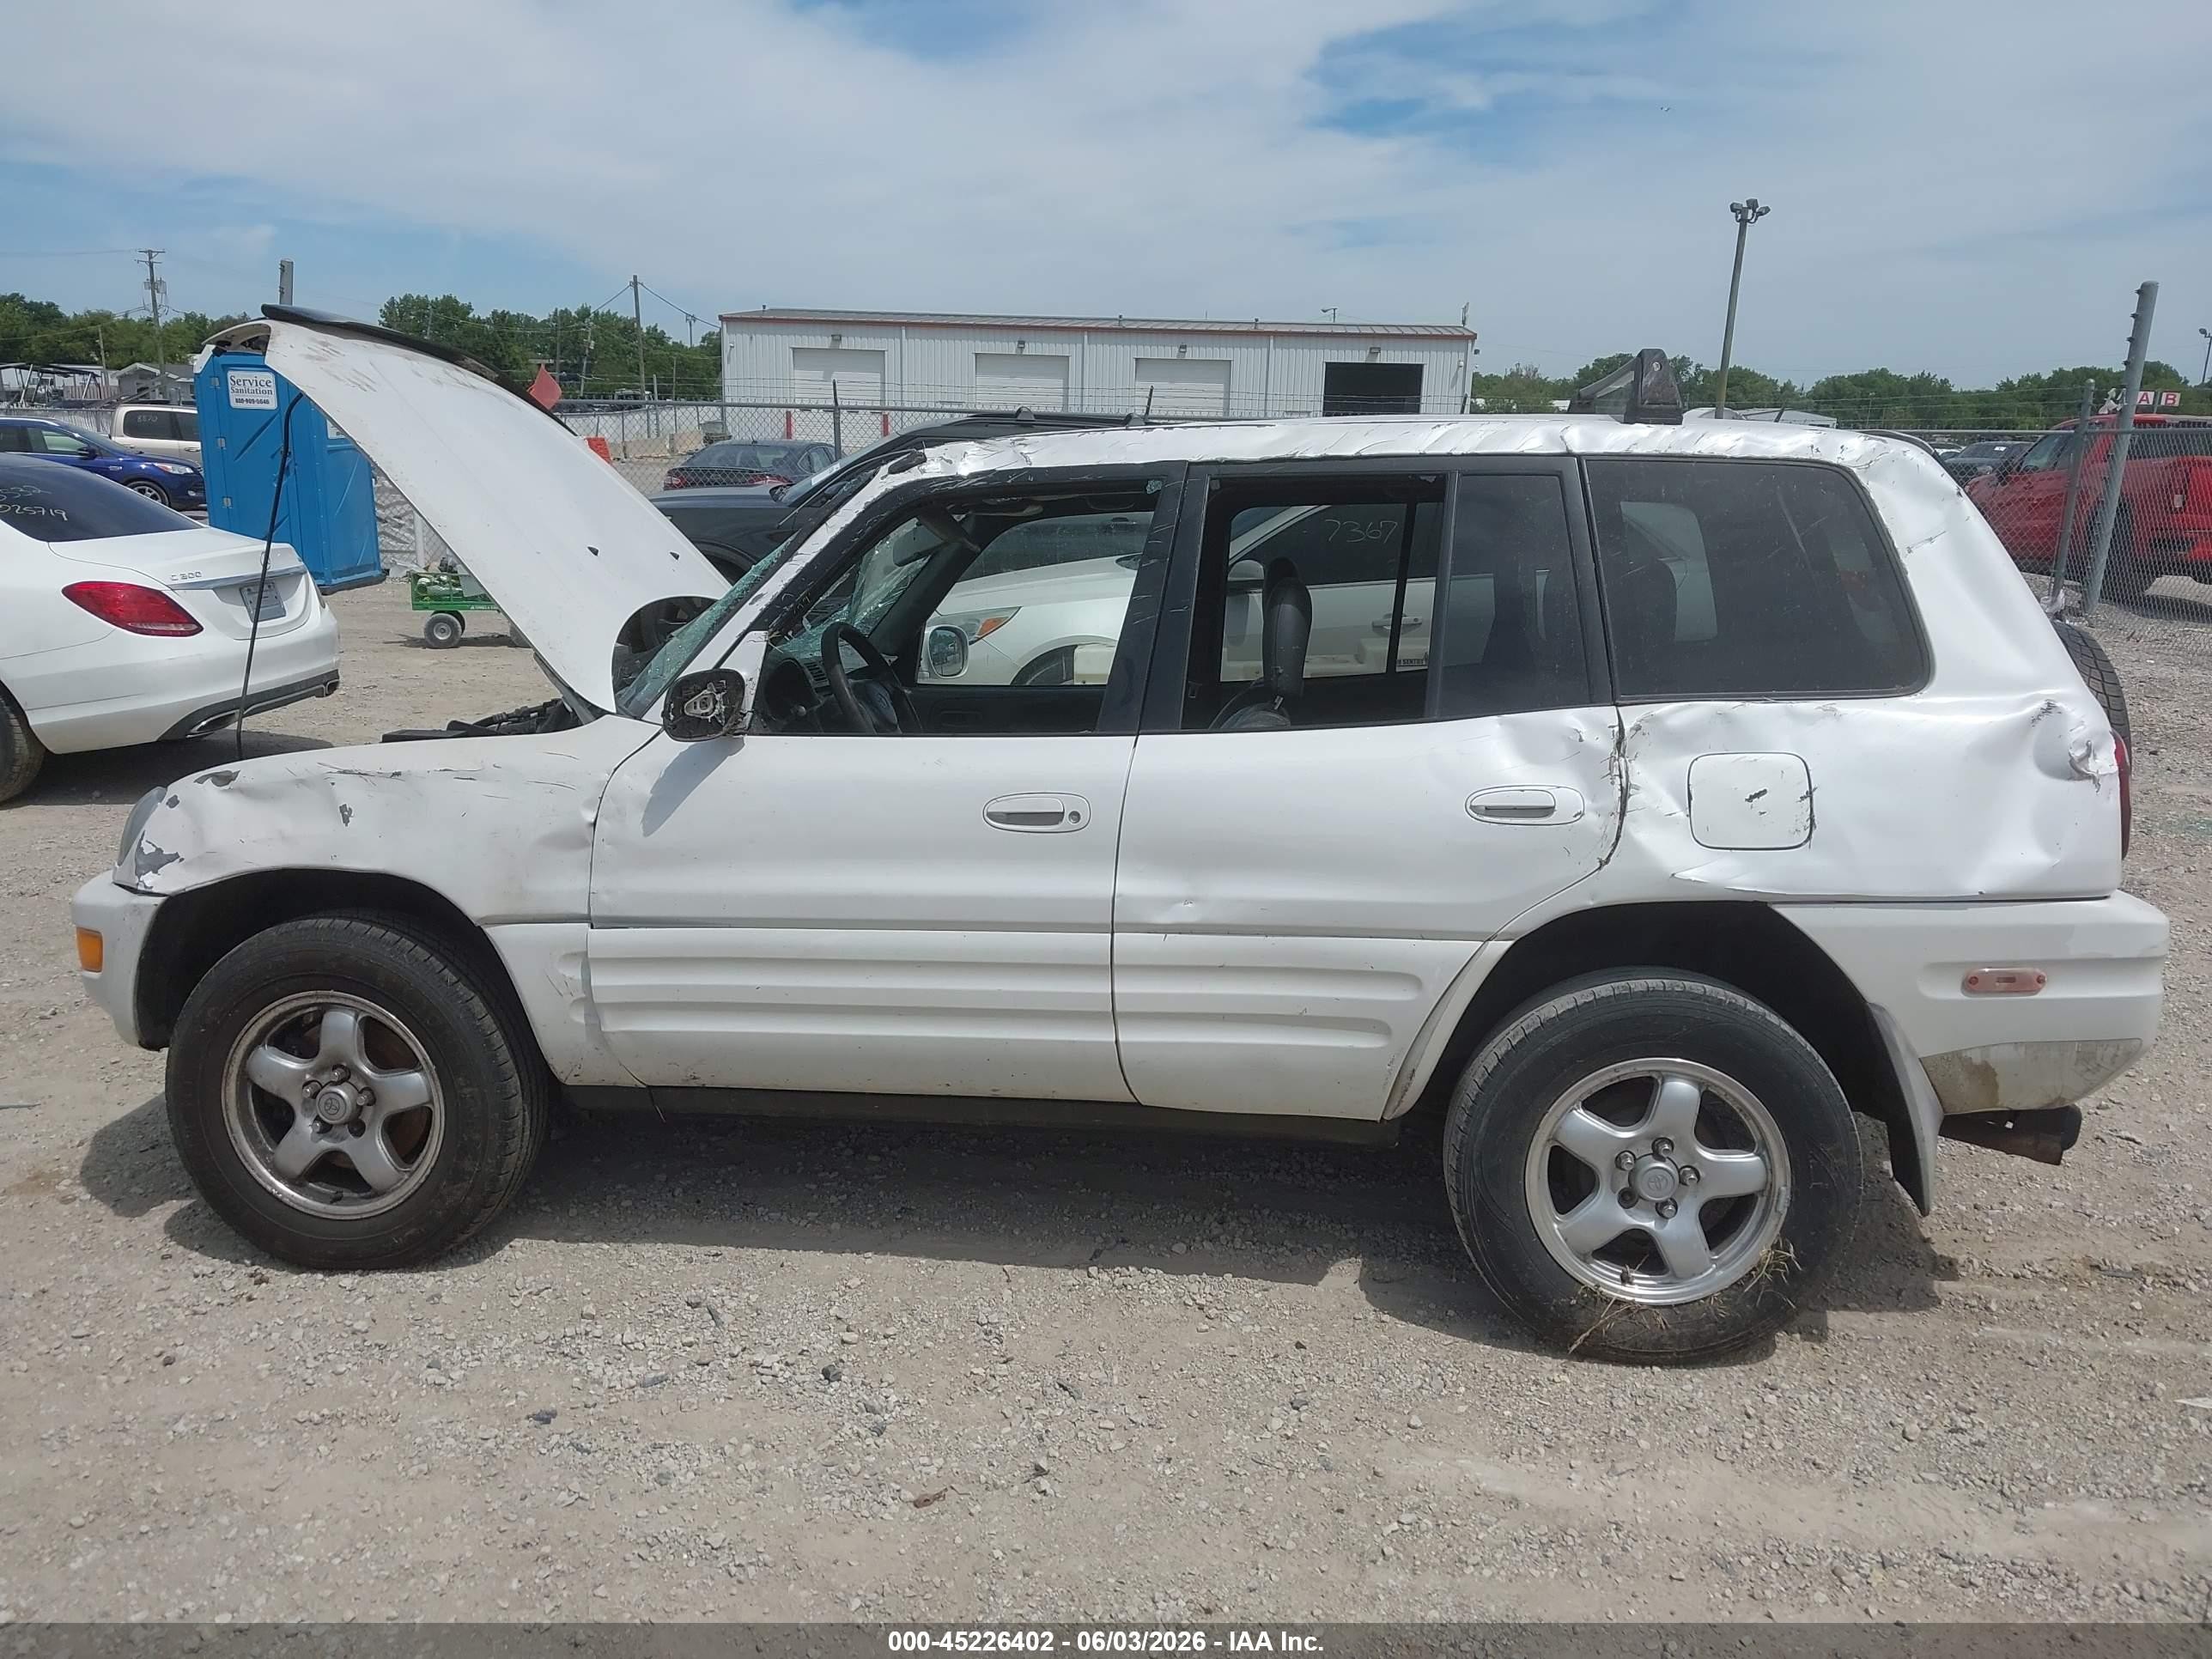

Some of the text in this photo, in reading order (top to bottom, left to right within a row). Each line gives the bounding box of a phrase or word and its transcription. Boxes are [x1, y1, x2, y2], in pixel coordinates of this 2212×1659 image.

[229, 375, 272, 387] Service
[230, 386, 273, 395] Sanitation
[2138, 392, 2150, 404] A
[2165, 393, 2177, 405] B
[1325, 519, 1398, 544] 7367
[179, 571, 202, 580] 300
